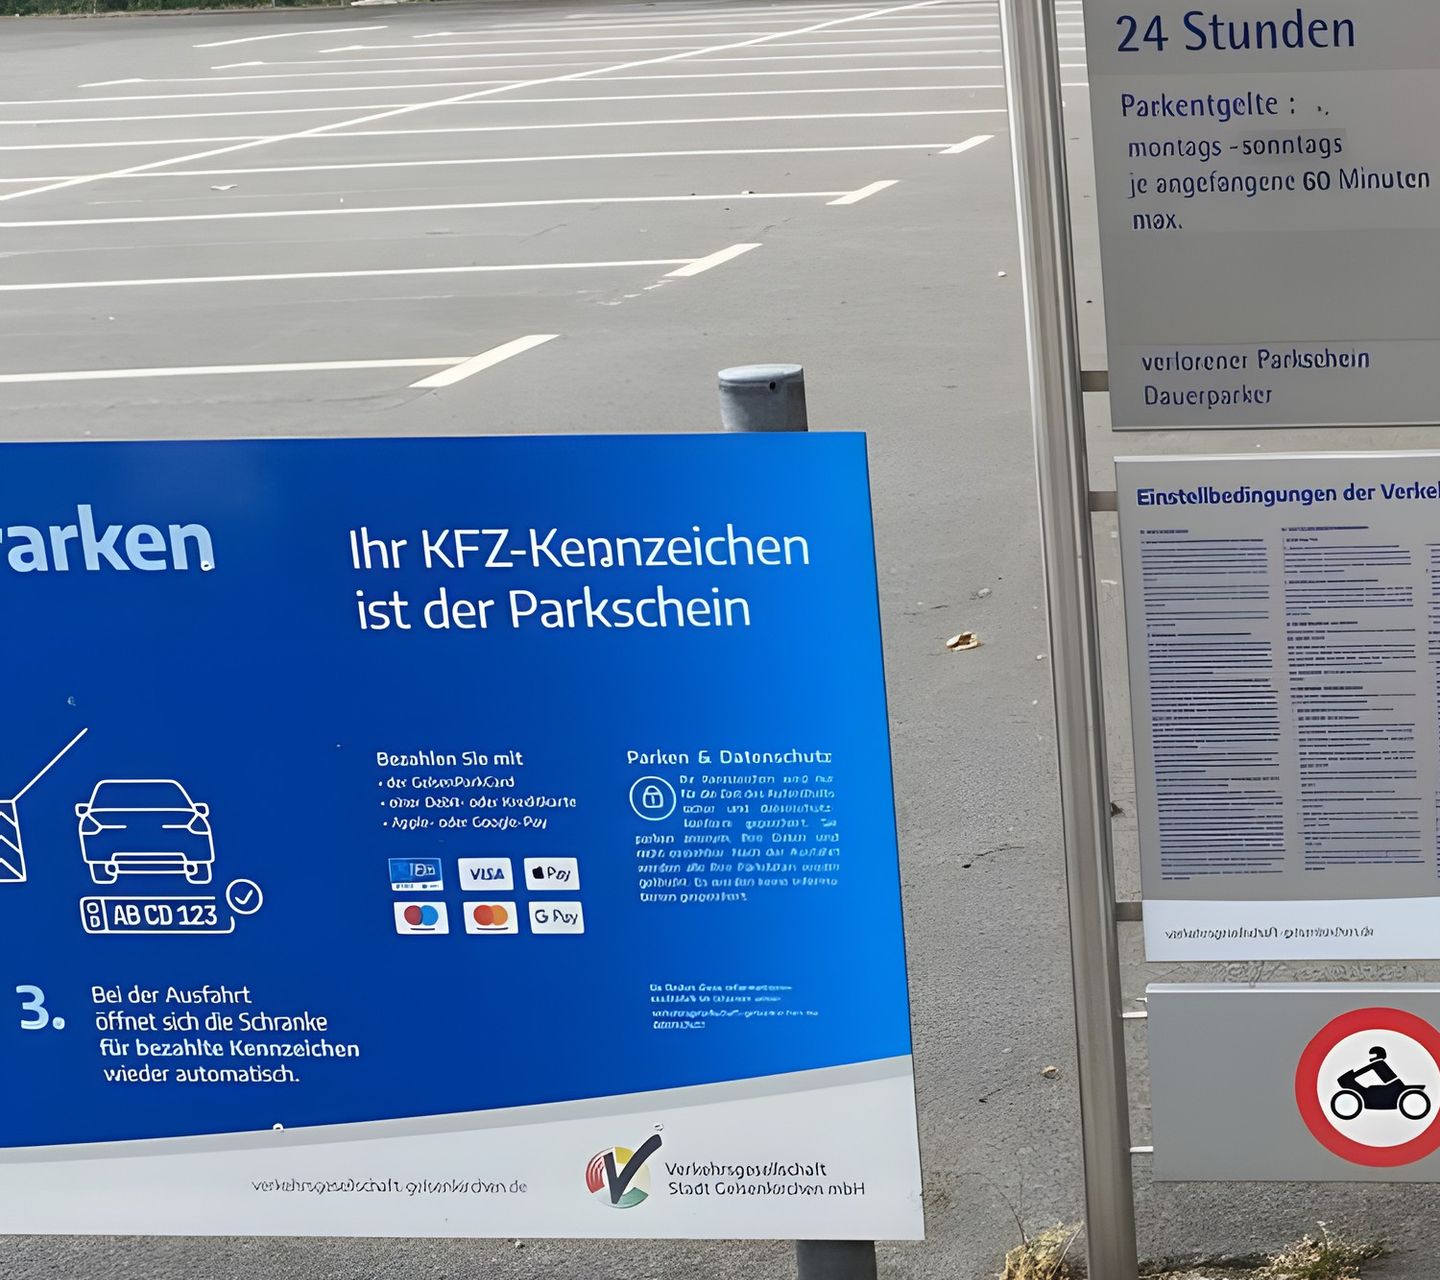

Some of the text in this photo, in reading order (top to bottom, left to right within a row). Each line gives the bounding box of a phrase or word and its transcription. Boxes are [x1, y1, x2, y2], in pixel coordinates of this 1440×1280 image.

[1116, 8, 1355, 52] 24 Stunden
[1121, 91, 1278, 123] Parkentgelte
[1128, 139, 1222, 163] montags
[1128, 166, 1430, 199] je angefangene 60 Minuten
[1133, 213, 1183, 230] max.
[1141, 347, 1370, 372] verlorener Parkschein
[1144, 384, 1273, 410] Dauerparker
[1136, 485, 1337, 508] Einstellbedingungen
[1342, 482, 1376, 501] der
[0, 503, 216, 573] arken
[349, 523, 810, 570] Ihr KFZ-Kennzeichen
[355, 584, 751, 630] ist der Parkschein
[461, 750, 489, 766] Sie
[493, 750, 524, 766] mit
[626, 748, 689, 765] Parken
[469, 867, 505, 881] VISA
[114, 904, 218, 926] AB CD 123
[91, 984, 253, 1004] Bei der Ausfahrt
[15, 984, 66, 1030] 3.
[95, 1010, 328, 1032] öffnet sich die Schranke
[99, 1038, 360, 1058] für bezahlte Kennzeichen
[103, 1063, 300, 1083] wieder automatisch.
[828, 1181, 865, 1196] mbH
